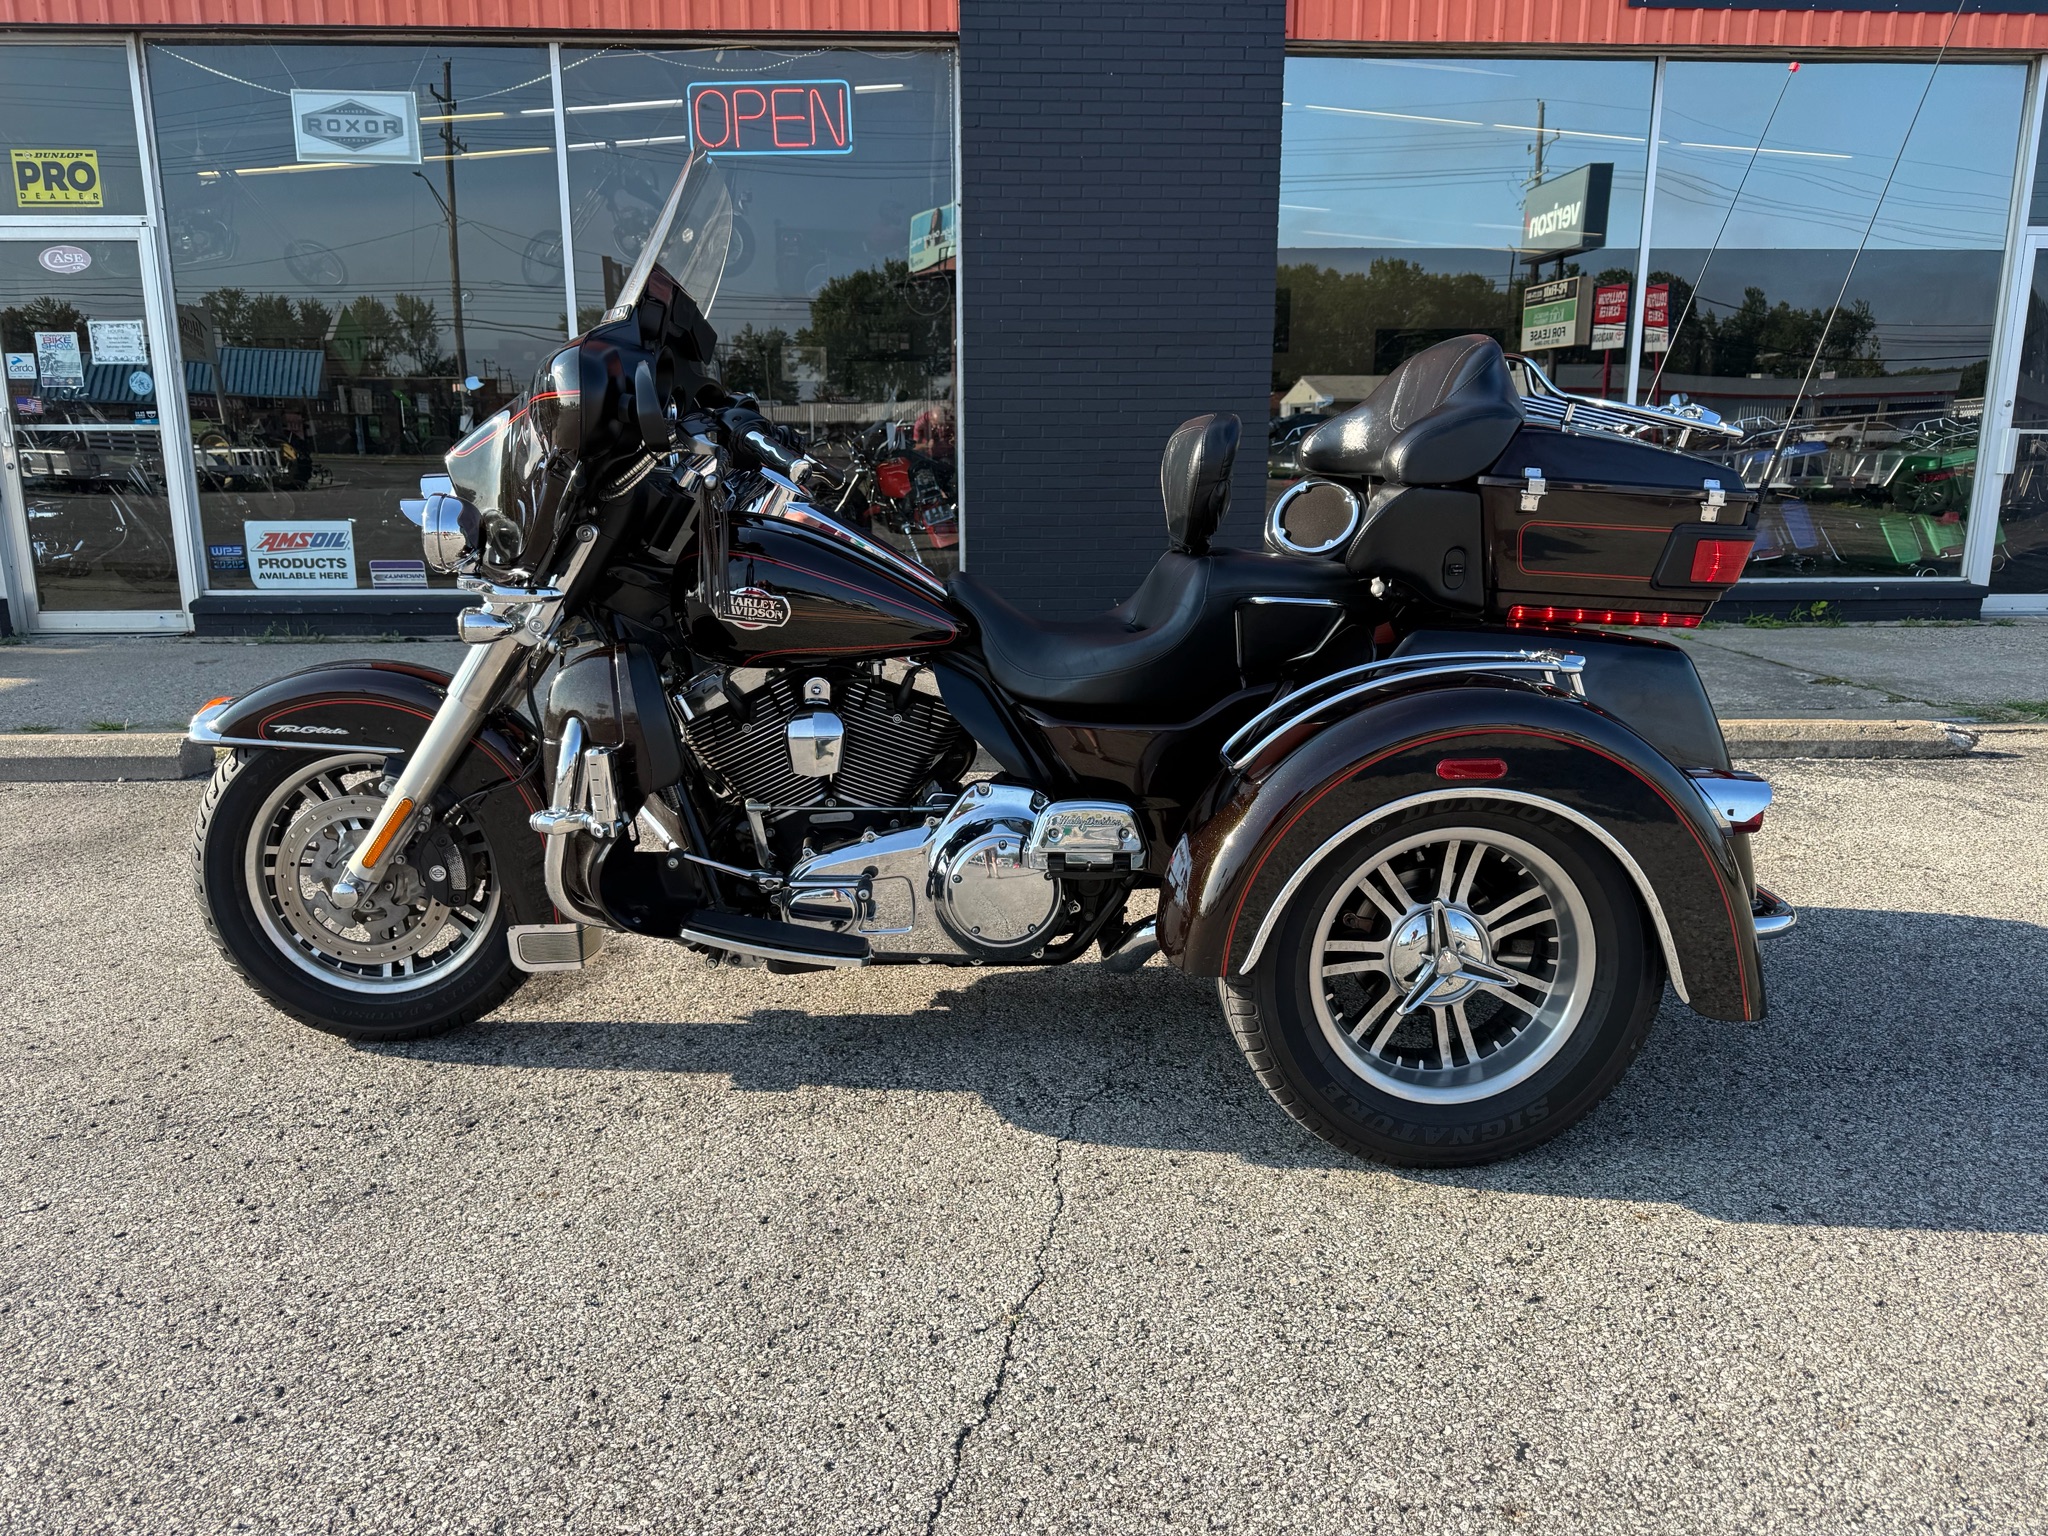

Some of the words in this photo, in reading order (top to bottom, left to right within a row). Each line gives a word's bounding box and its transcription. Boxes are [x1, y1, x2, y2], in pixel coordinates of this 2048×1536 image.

[695, 88, 845, 148] OPEN
[307, 118, 399, 134] ROXOR
[16, 160, 97, 191] PRO
[20, 192, 100, 200] DEALER
[43, 336, 72, 344] BIKE
[9, 363, 34, 373] cardo
[257, 532, 349, 552] AMSOIL
[211, 546, 243, 556] WPS
[258, 558, 347, 569] PRODUCTS
[259, 572, 317, 580] AVAILABLE
[319, 572, 348, 580] HERE
[1320, 1082, 1550, 1145] SIGNATURE
